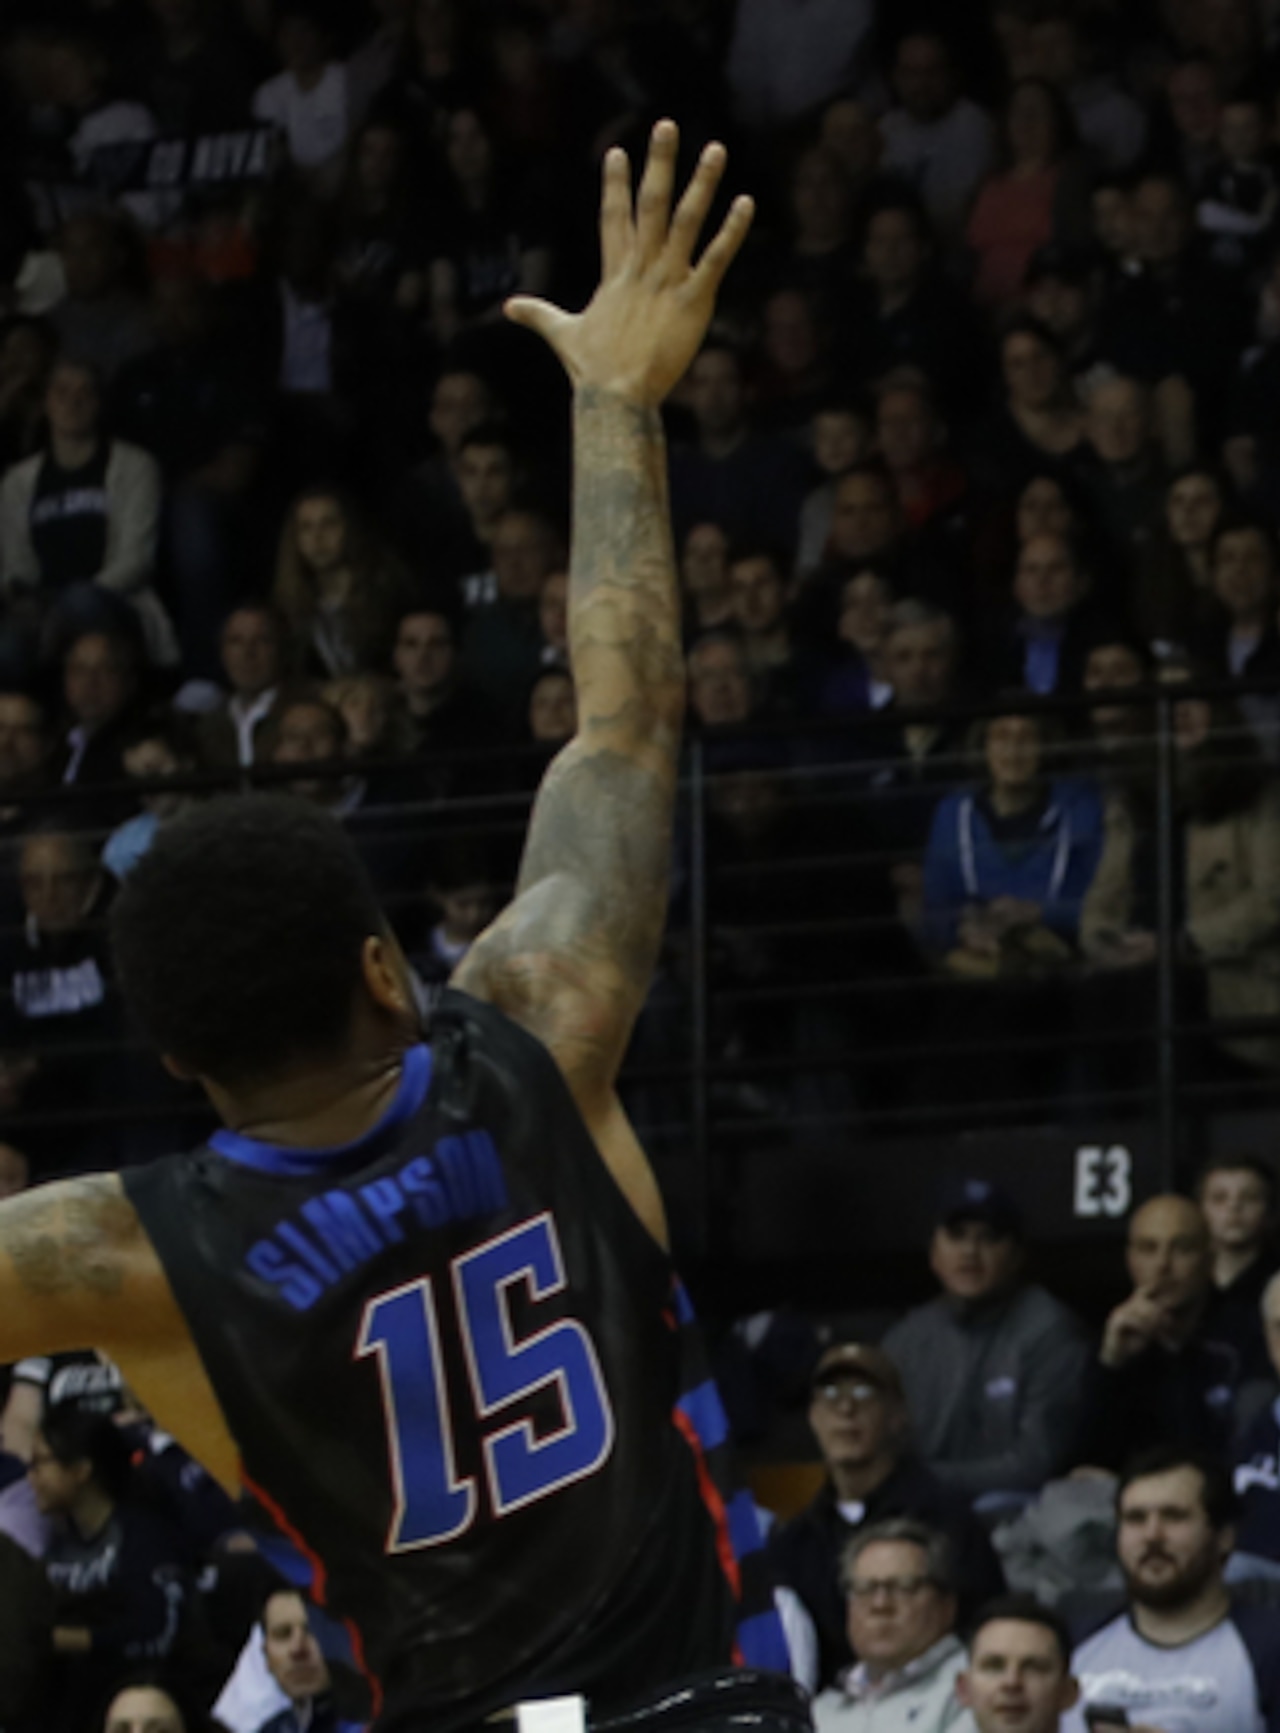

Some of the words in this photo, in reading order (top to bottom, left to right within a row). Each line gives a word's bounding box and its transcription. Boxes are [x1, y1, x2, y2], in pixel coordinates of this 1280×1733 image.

[246, 1130, 507, 1311] SIMPSON
[1074, 1146, 1131, 1216] E3
[353, 1210, 615, 1555] 15
